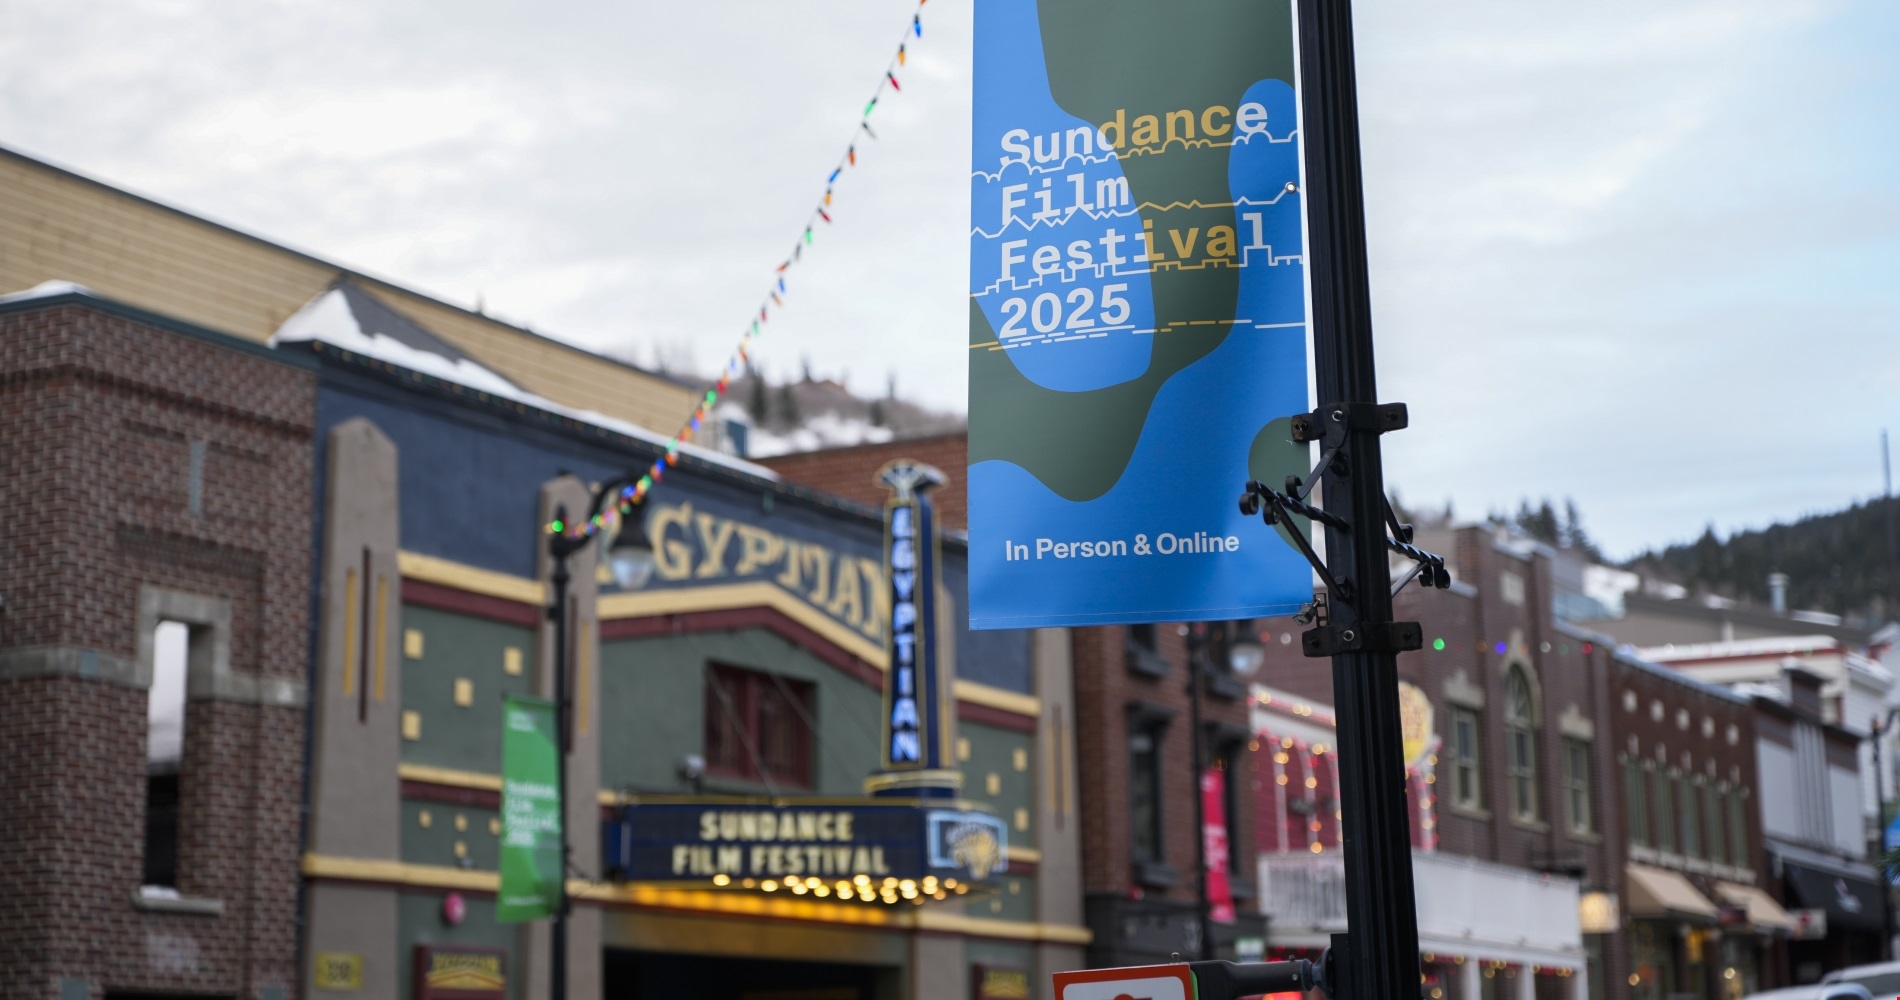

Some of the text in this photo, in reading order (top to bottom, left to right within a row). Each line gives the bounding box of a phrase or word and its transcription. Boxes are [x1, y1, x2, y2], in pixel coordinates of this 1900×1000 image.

[999, 102, 1268, 167] Sundance
[1001, 173, 1129, 226] Film
[1001, 212, 1266, 281] Festival
[999, 283, 1131, 339] 2025
[1005, 531, 1240, 561] In Person & Online
[891, 507, 921, 762] EGYPTIAN
[699, 811, 854, 841] SUNDANCE
[672, 844, 889, 876] FILM FESTIVAL
